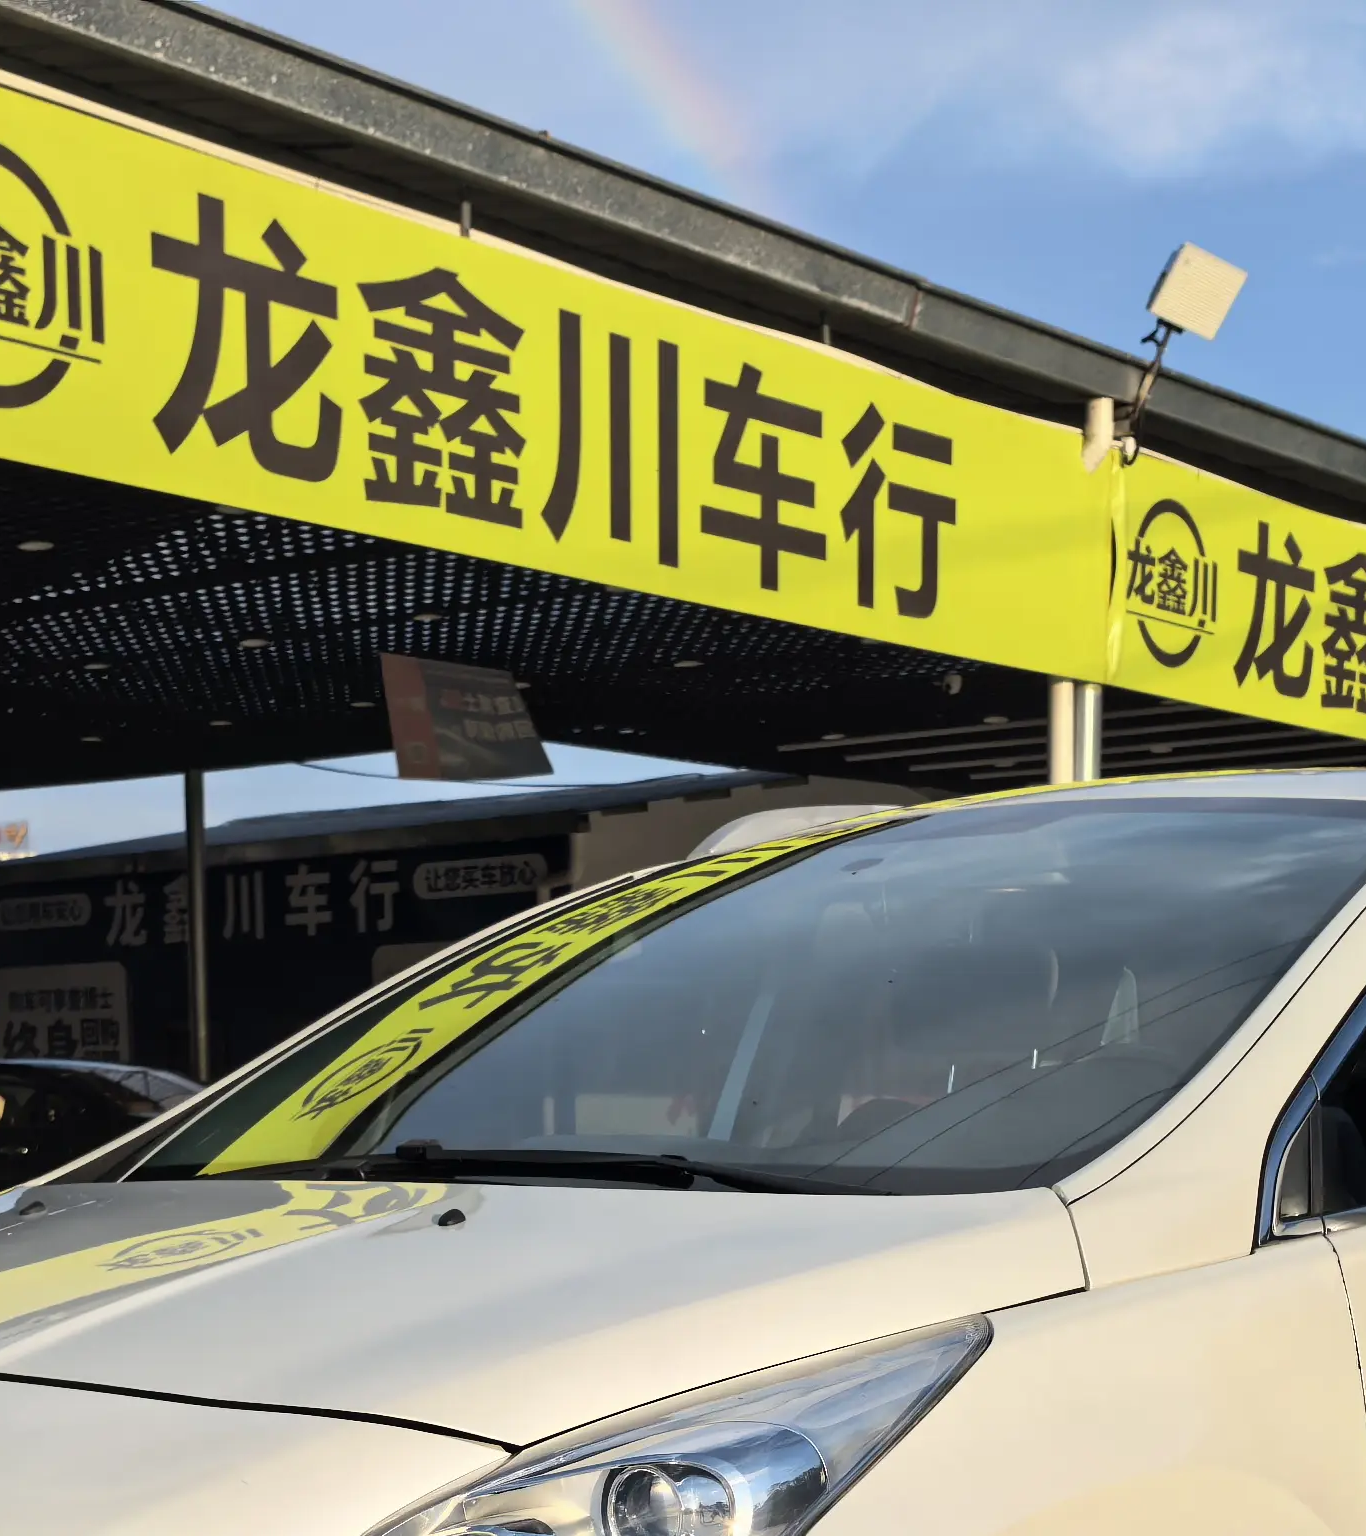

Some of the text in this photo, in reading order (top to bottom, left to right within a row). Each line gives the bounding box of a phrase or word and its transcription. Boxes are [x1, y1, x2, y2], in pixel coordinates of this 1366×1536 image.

[150, 192, 957, 619] 龙鑫川车行
[1126, 537, 1218, 622] 龙鑫川
